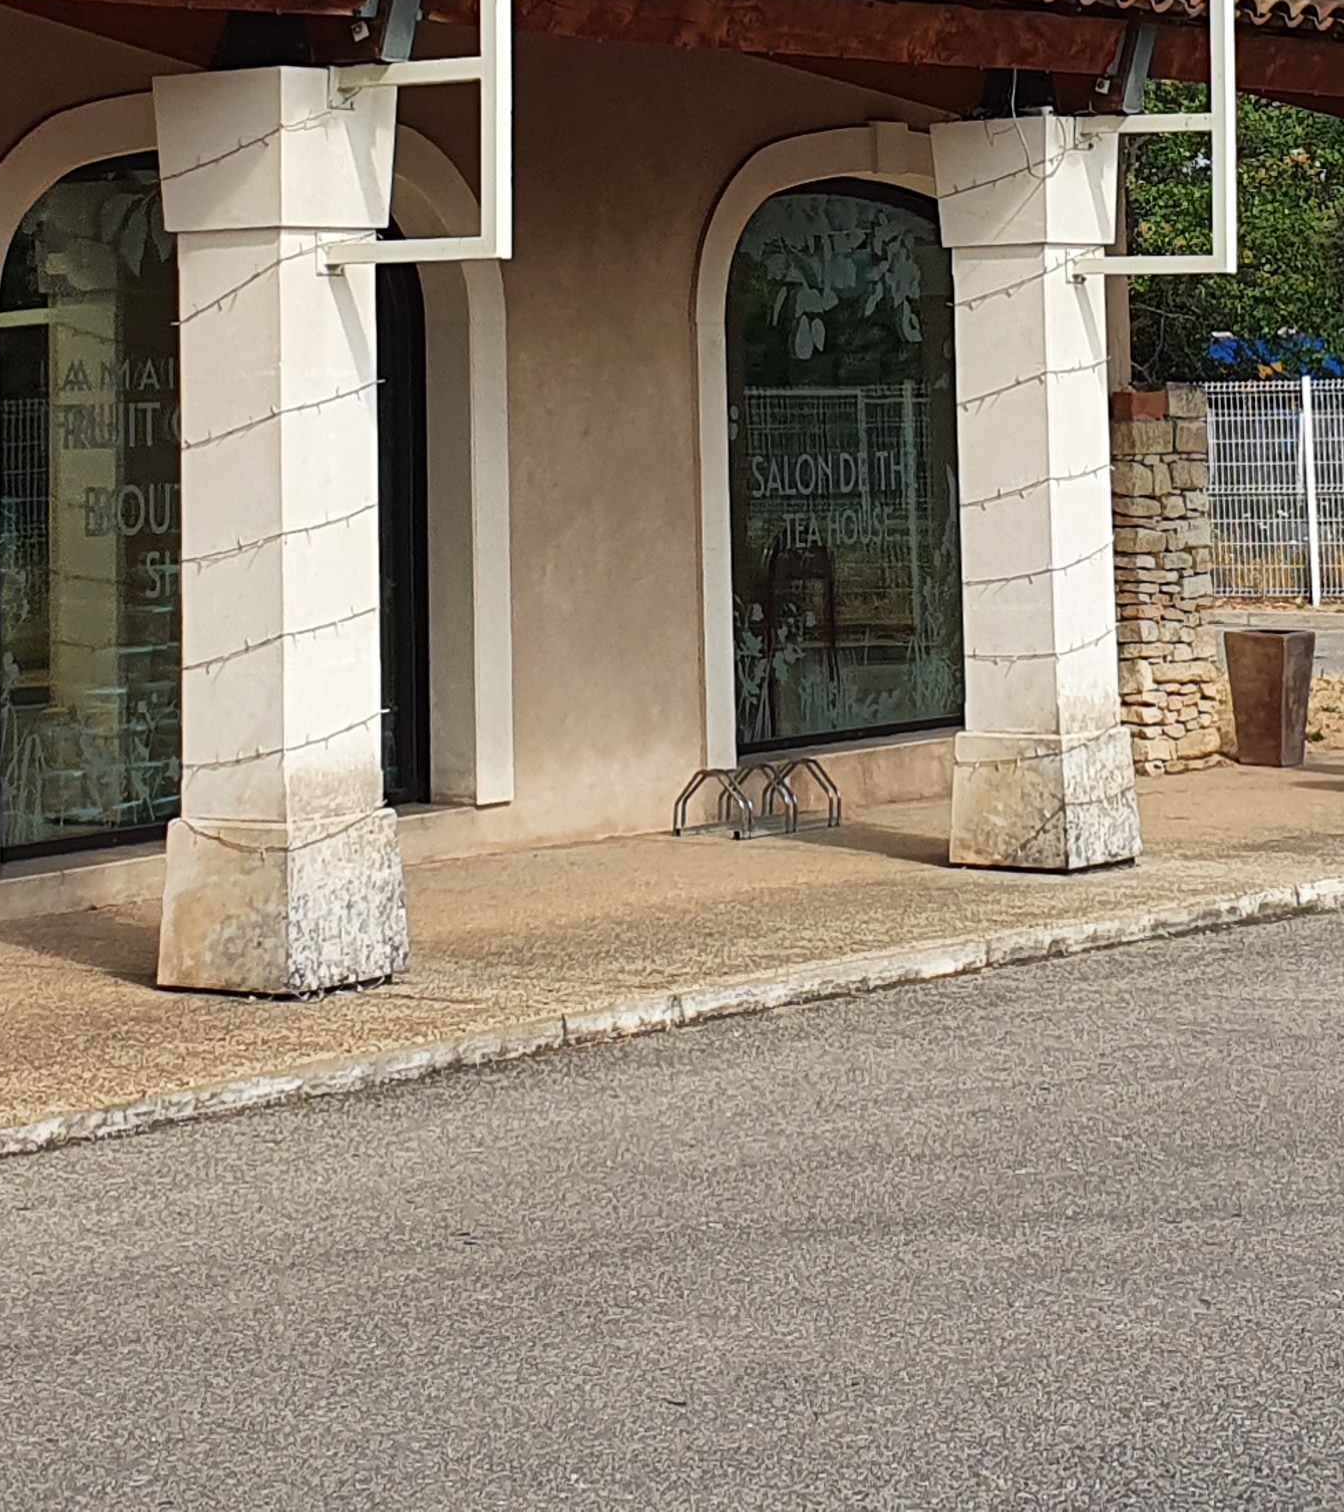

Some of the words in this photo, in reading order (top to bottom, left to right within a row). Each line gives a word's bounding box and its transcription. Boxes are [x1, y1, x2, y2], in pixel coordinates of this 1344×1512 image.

[751, 454, 832, 498] SALON
[783, 512, 823, 549] TEA
[828, 506, 895, 546] HOUSE
